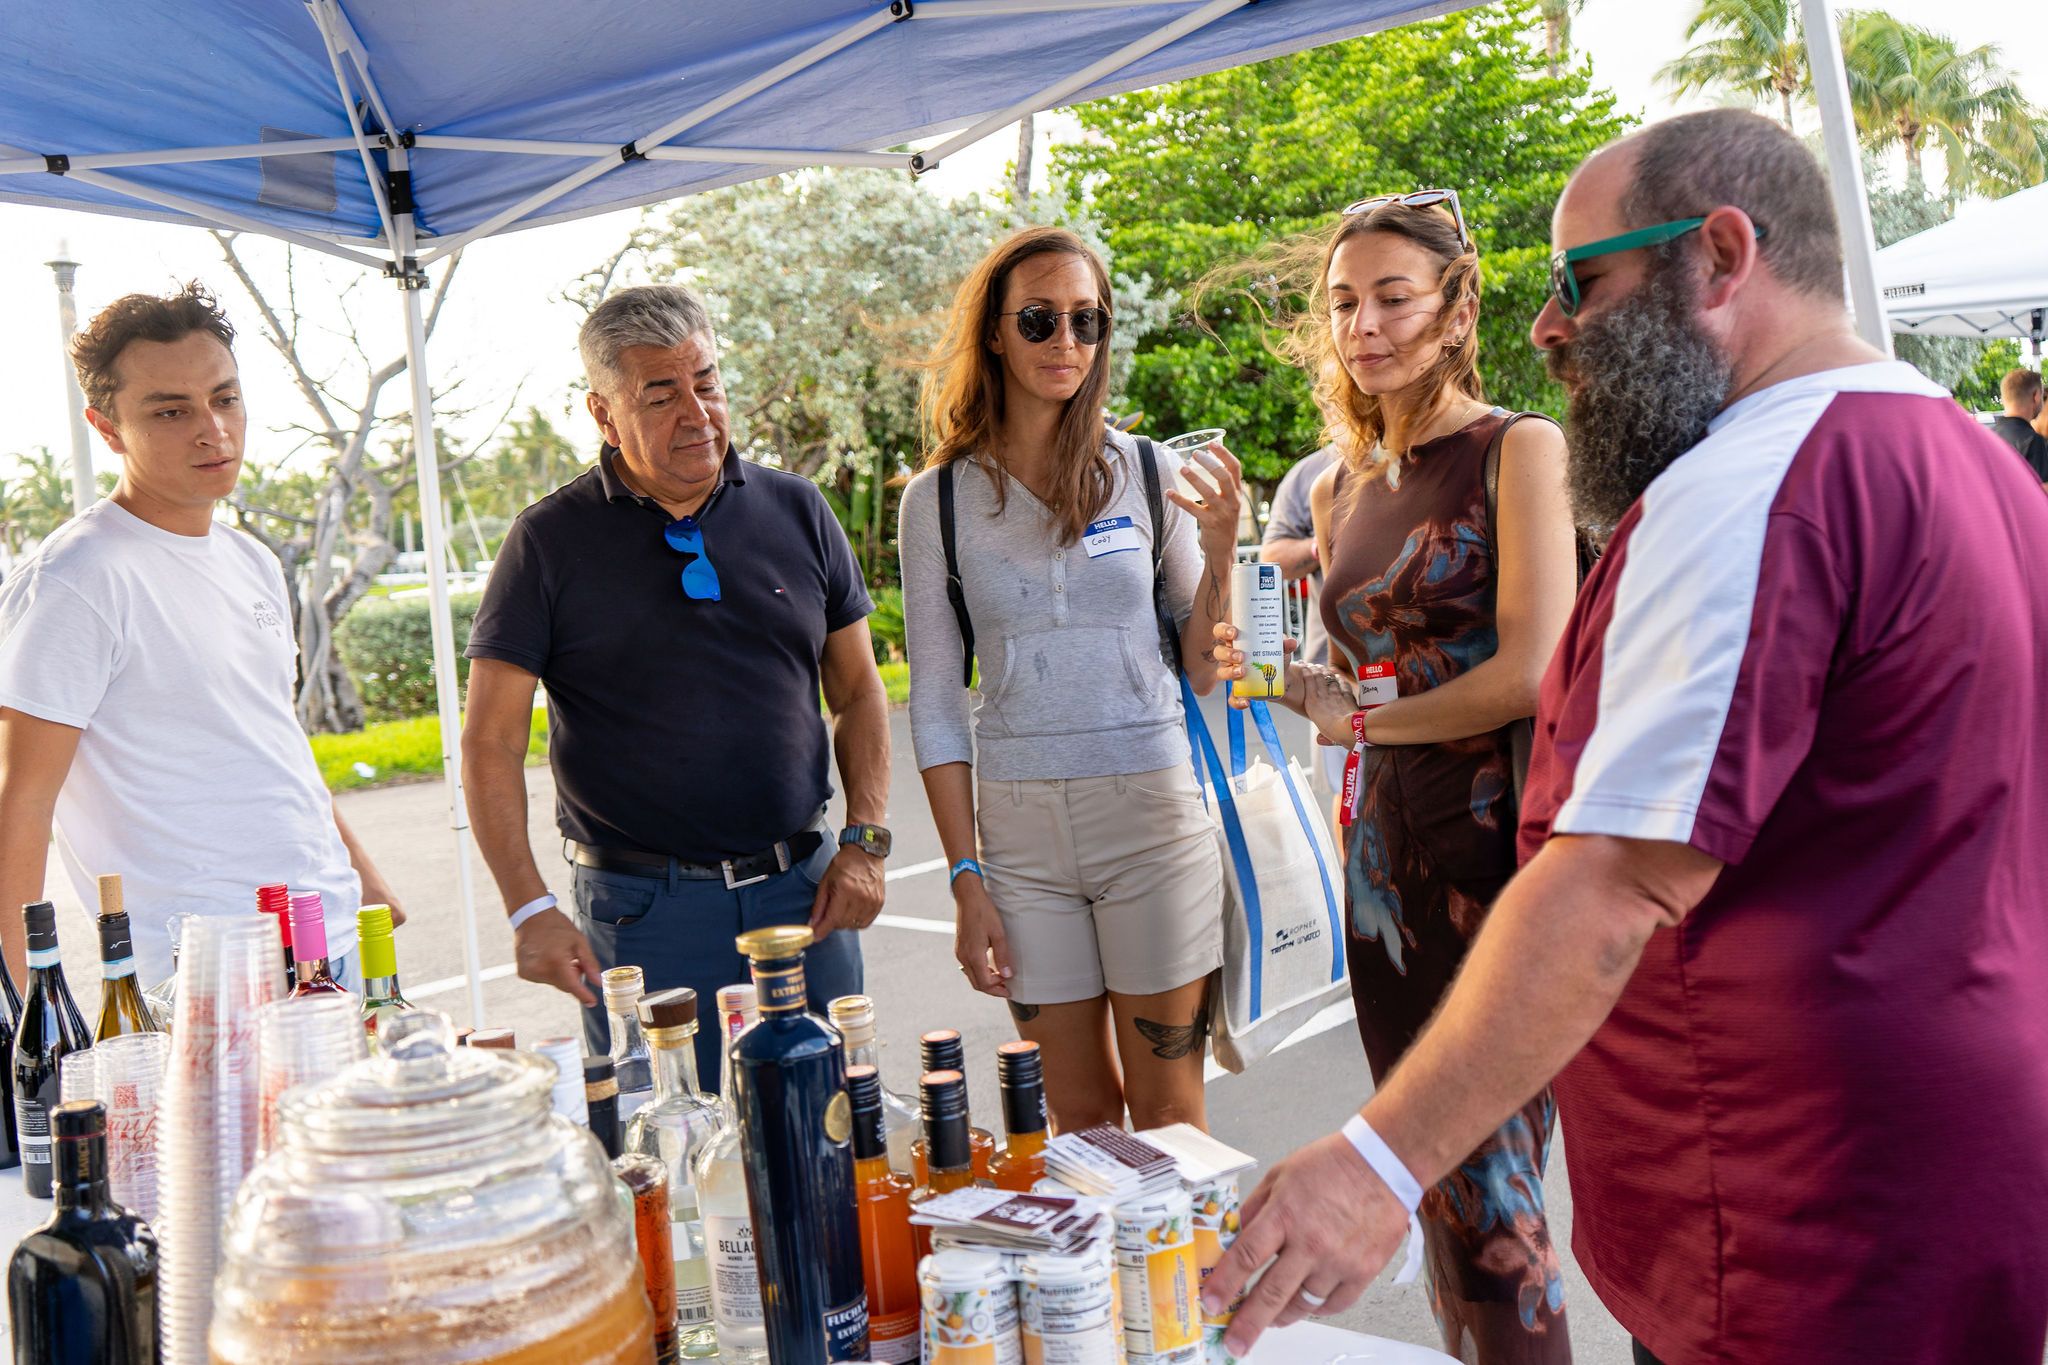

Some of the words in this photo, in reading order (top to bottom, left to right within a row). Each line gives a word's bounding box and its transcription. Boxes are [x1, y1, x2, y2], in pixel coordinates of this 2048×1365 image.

[1094, 519, 1118, 530] HELLO
[1261, 576, 1275, 584] TWO
[1366, 665, 1383, 674] HELLO
[1343, 767, 1357, 808] TRITON
[1290, 918, 1317, 934] ROPNER
[1117, 1224, 1142, 1233] Facts
[1131, 1255, 1145, 1264] 80
[1039, 1286, 1086, 1298] Nutrition
[827, 1305, 863, 1328] FLECHA
[837, 1321, 862, 1340] EXTRA
[1042, 1321, 1076, 1331] Calories
